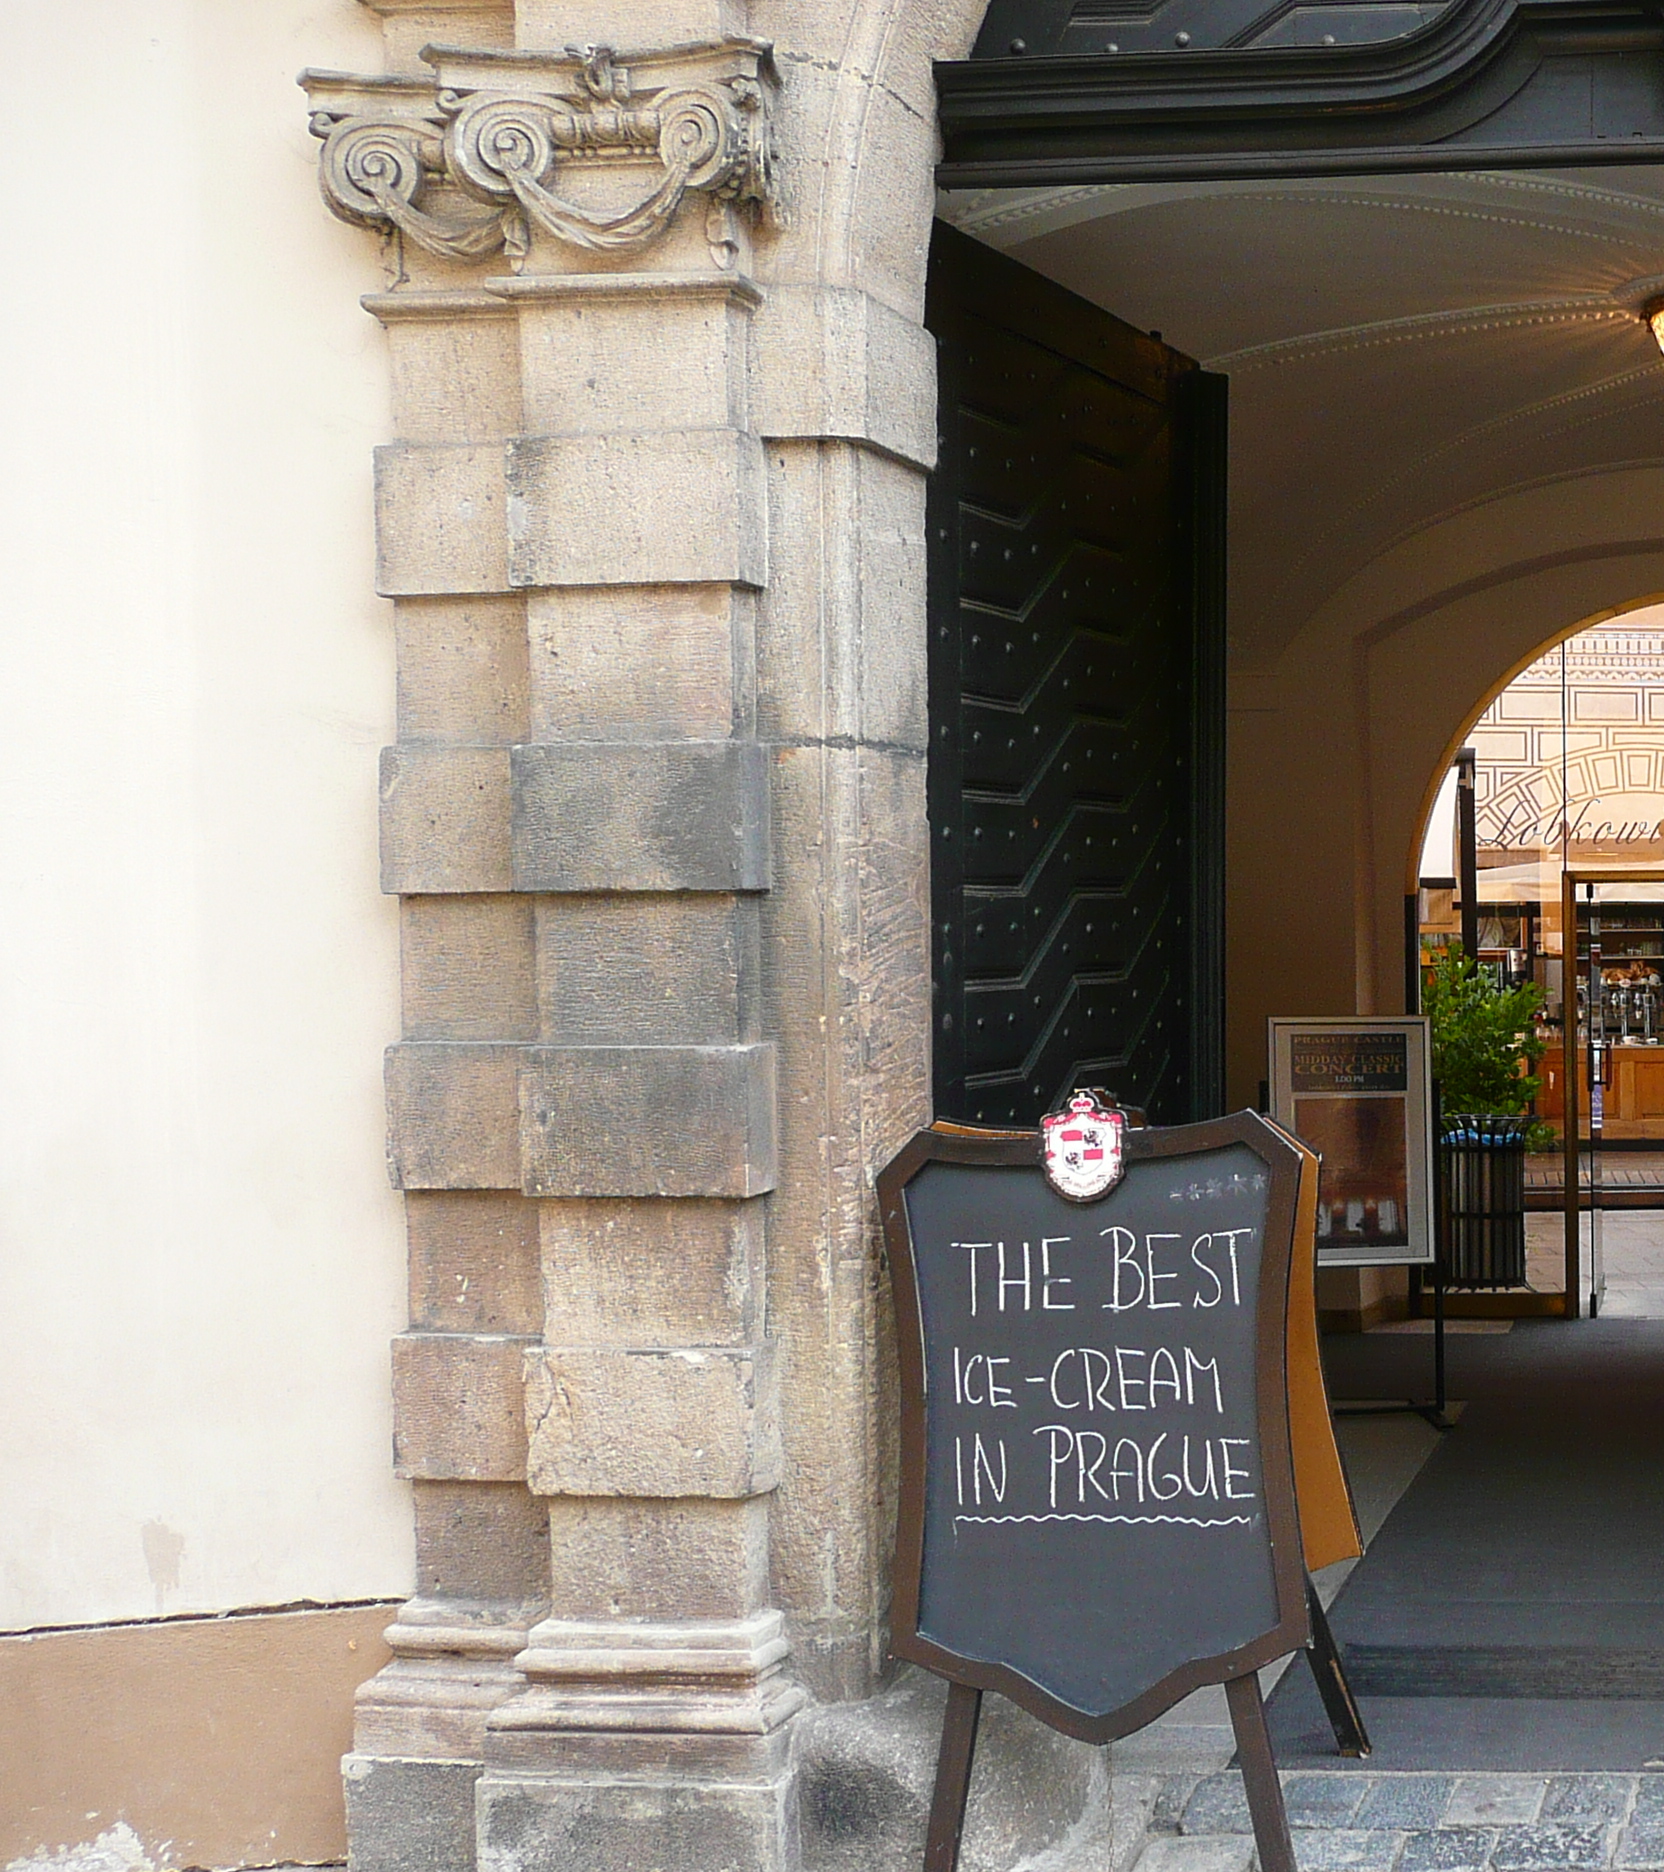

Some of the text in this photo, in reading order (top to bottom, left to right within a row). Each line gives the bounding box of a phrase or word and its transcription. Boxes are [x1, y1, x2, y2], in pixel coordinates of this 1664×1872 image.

[1294, 1035, 1404, 1044] PRAGUE CASTLE
[1294, 1054, 1347, 1065] MIDDAY
[1294, 1064, 1401, 1074] CONCERT
[950, 1226, 1254, 1318] THE BEST
[953, 1346, 1225, 1414] ICE-CREAM
[955, 1424, 1256, 1509] IN PRAGUE
